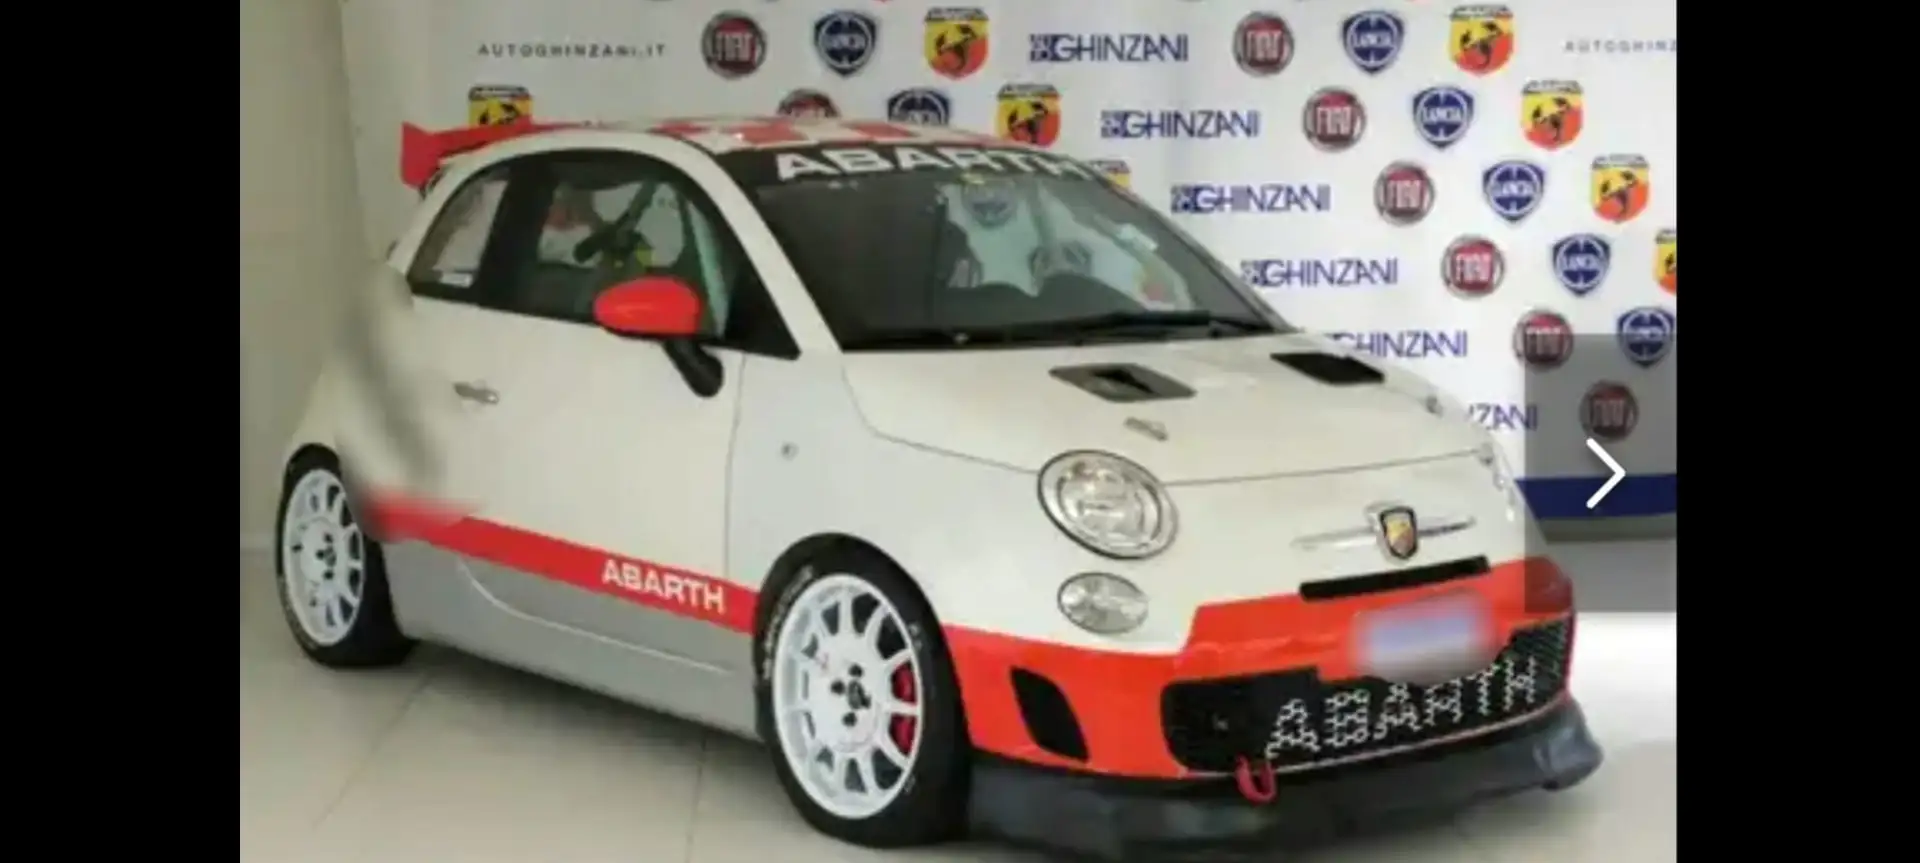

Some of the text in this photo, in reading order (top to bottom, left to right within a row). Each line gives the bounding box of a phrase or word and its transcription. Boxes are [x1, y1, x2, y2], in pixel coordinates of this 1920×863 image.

[1056, 34, 1189, 62] GHINZANI
[1123, 110, 1260, 138] GHINZANI
[1336, 331, 1468, 357] HINZANI
[601, 558, 725, 614] ABARTH
